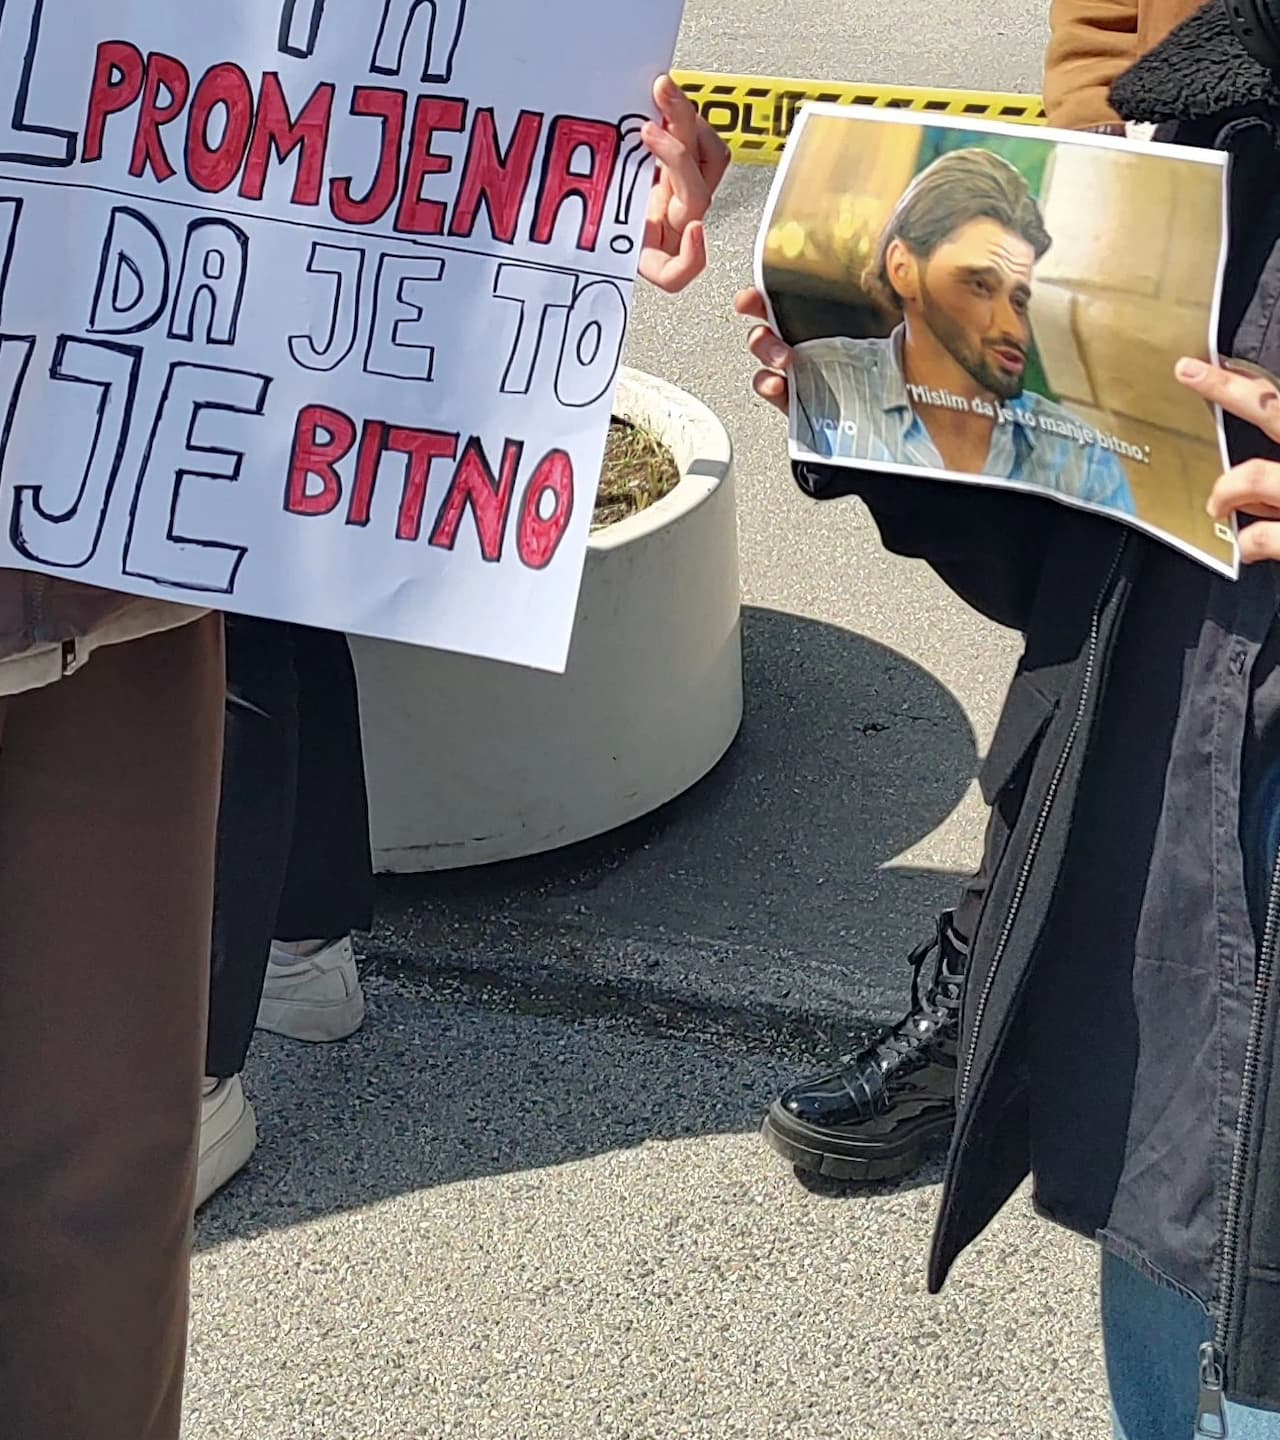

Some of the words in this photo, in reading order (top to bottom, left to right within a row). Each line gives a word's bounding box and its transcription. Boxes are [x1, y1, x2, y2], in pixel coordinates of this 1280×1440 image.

[88, 205, 250, 345] DA
[288, 241, 446, 382] JE
[492, 258, 628, 408] TO
[284, 404, 573, 570] BITNO
[971, 396, 995, 418] da
[994, 400, 1014, 424] je
[1015, 407, 1036, 427] to
[1039, 415, 1094, 445] manje
